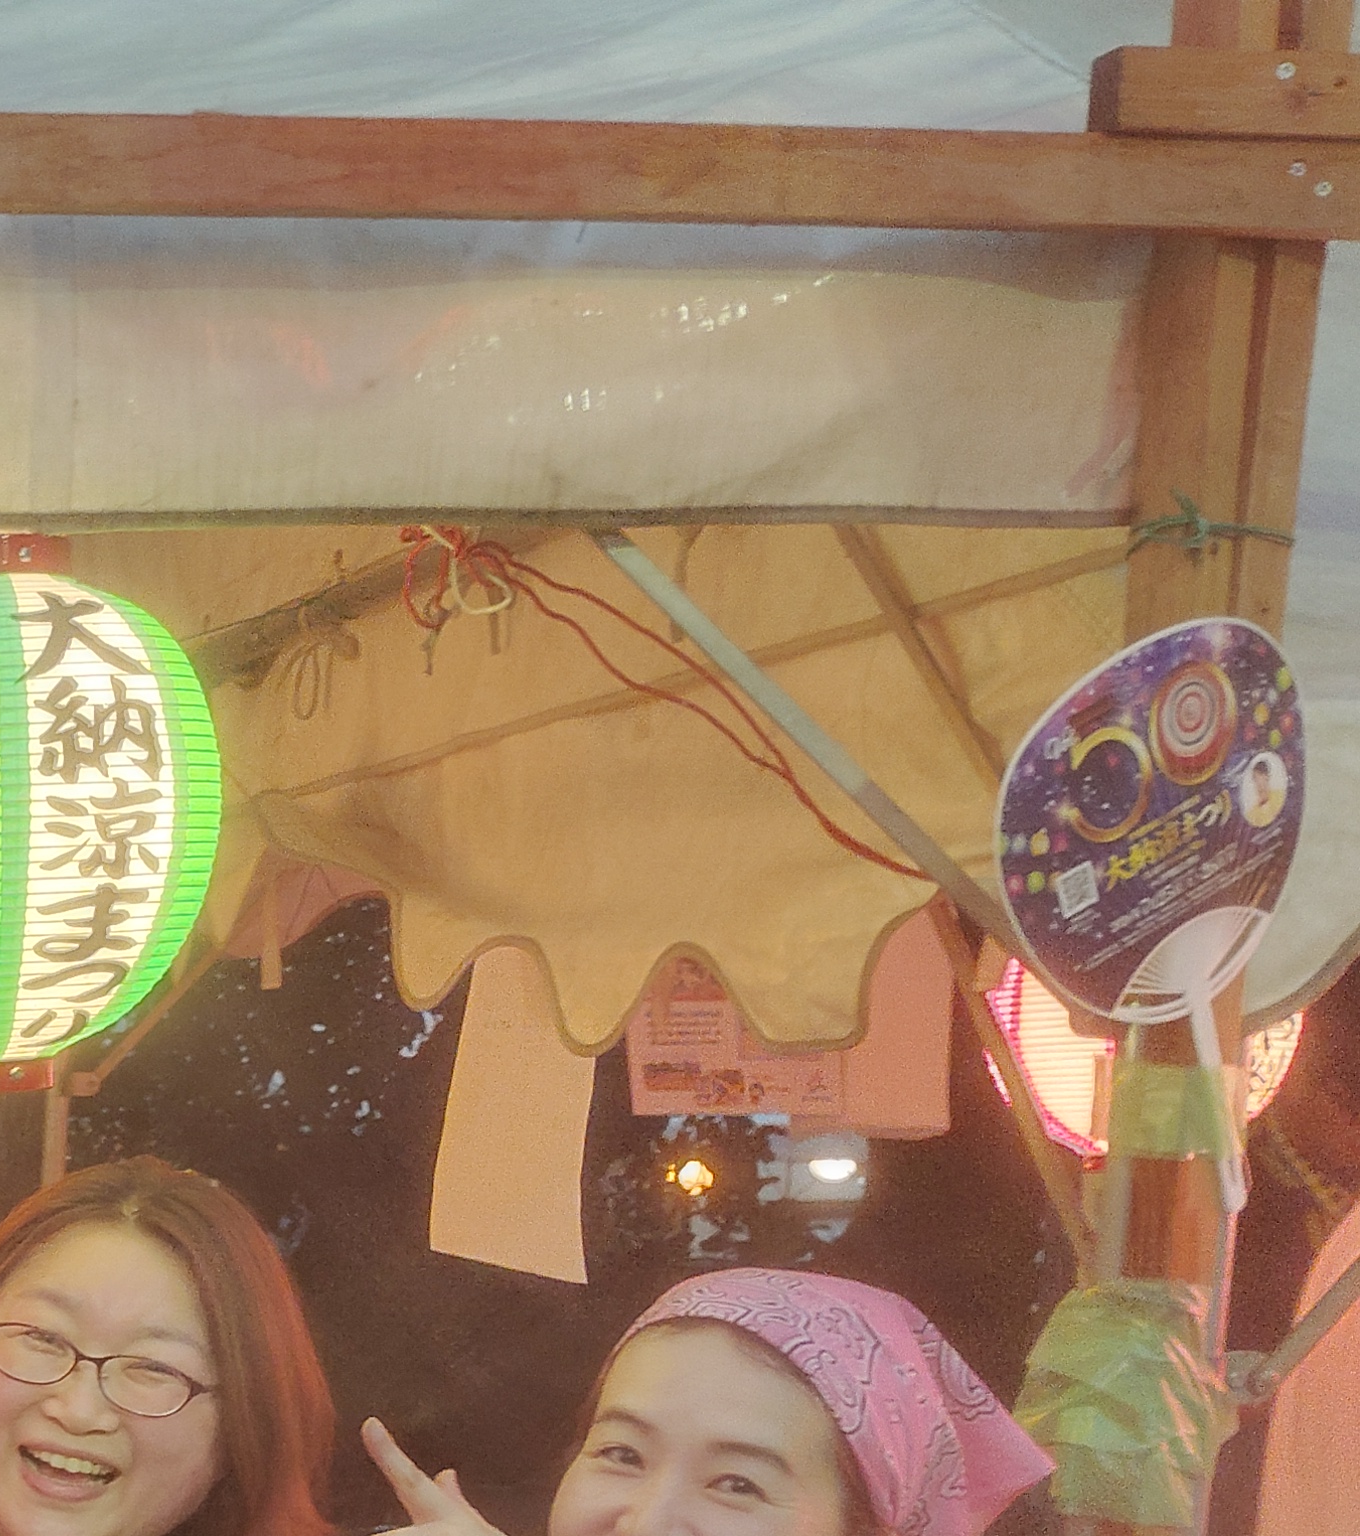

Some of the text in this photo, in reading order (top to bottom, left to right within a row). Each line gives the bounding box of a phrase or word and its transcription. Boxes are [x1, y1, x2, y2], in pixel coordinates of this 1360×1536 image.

[10, 590, 164, 1047] 大納涼まつり
